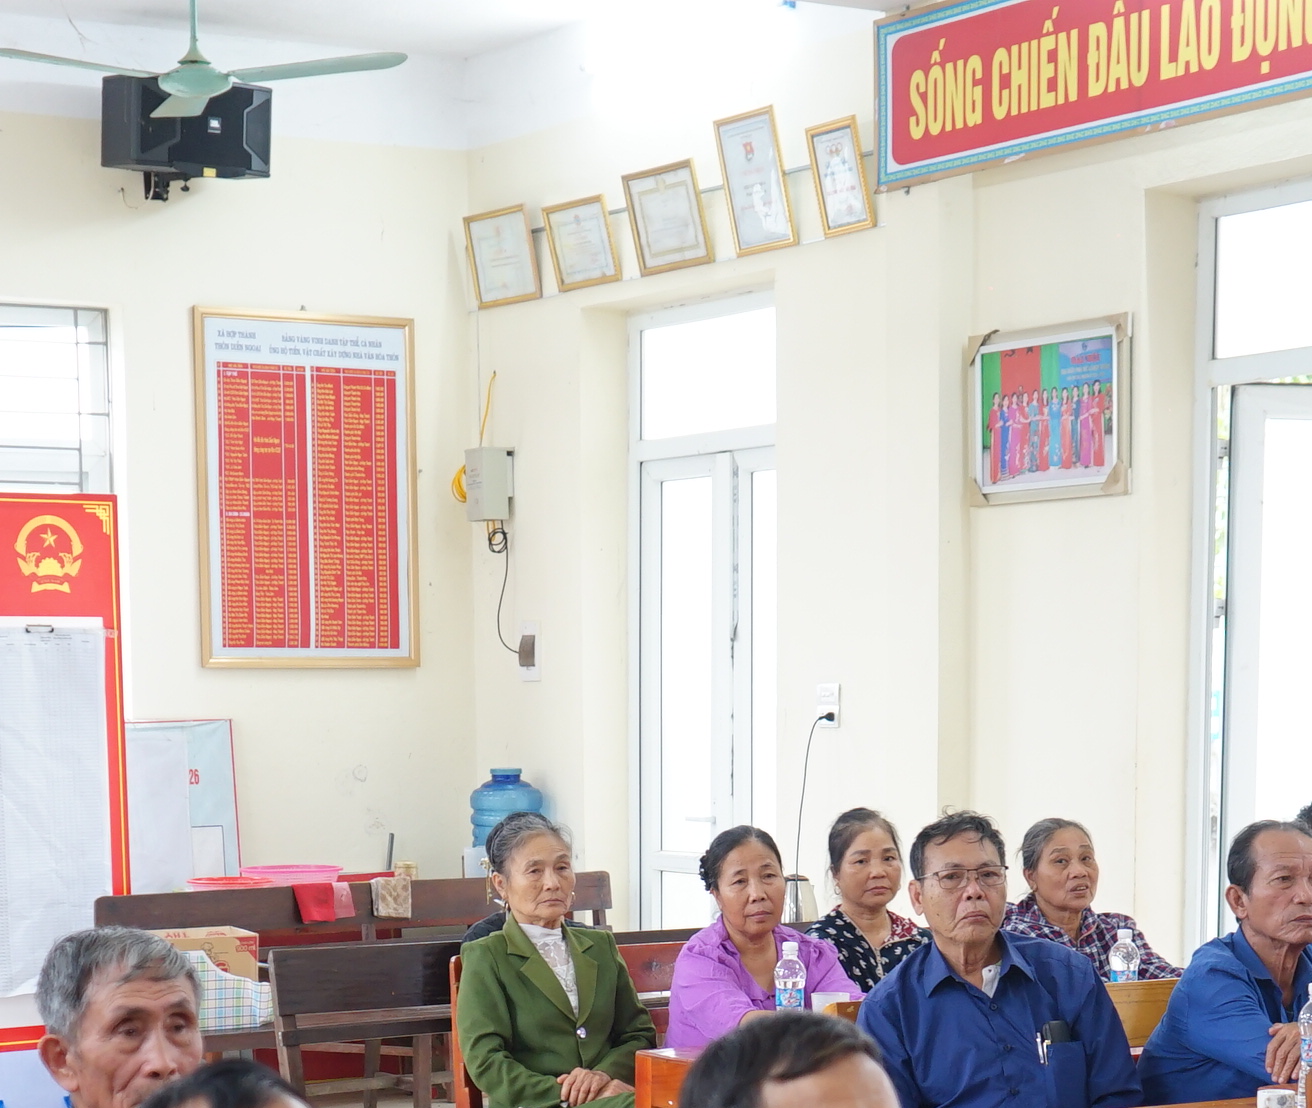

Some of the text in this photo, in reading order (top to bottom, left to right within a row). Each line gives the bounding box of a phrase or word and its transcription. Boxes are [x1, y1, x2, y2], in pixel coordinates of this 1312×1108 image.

[910, 39, 982, 139] SỐNG
[992, 7, 1078, 119] CHIẾN
[1161, 0, 1220, 79] LAO
[189, 769, 200, 785] 26
